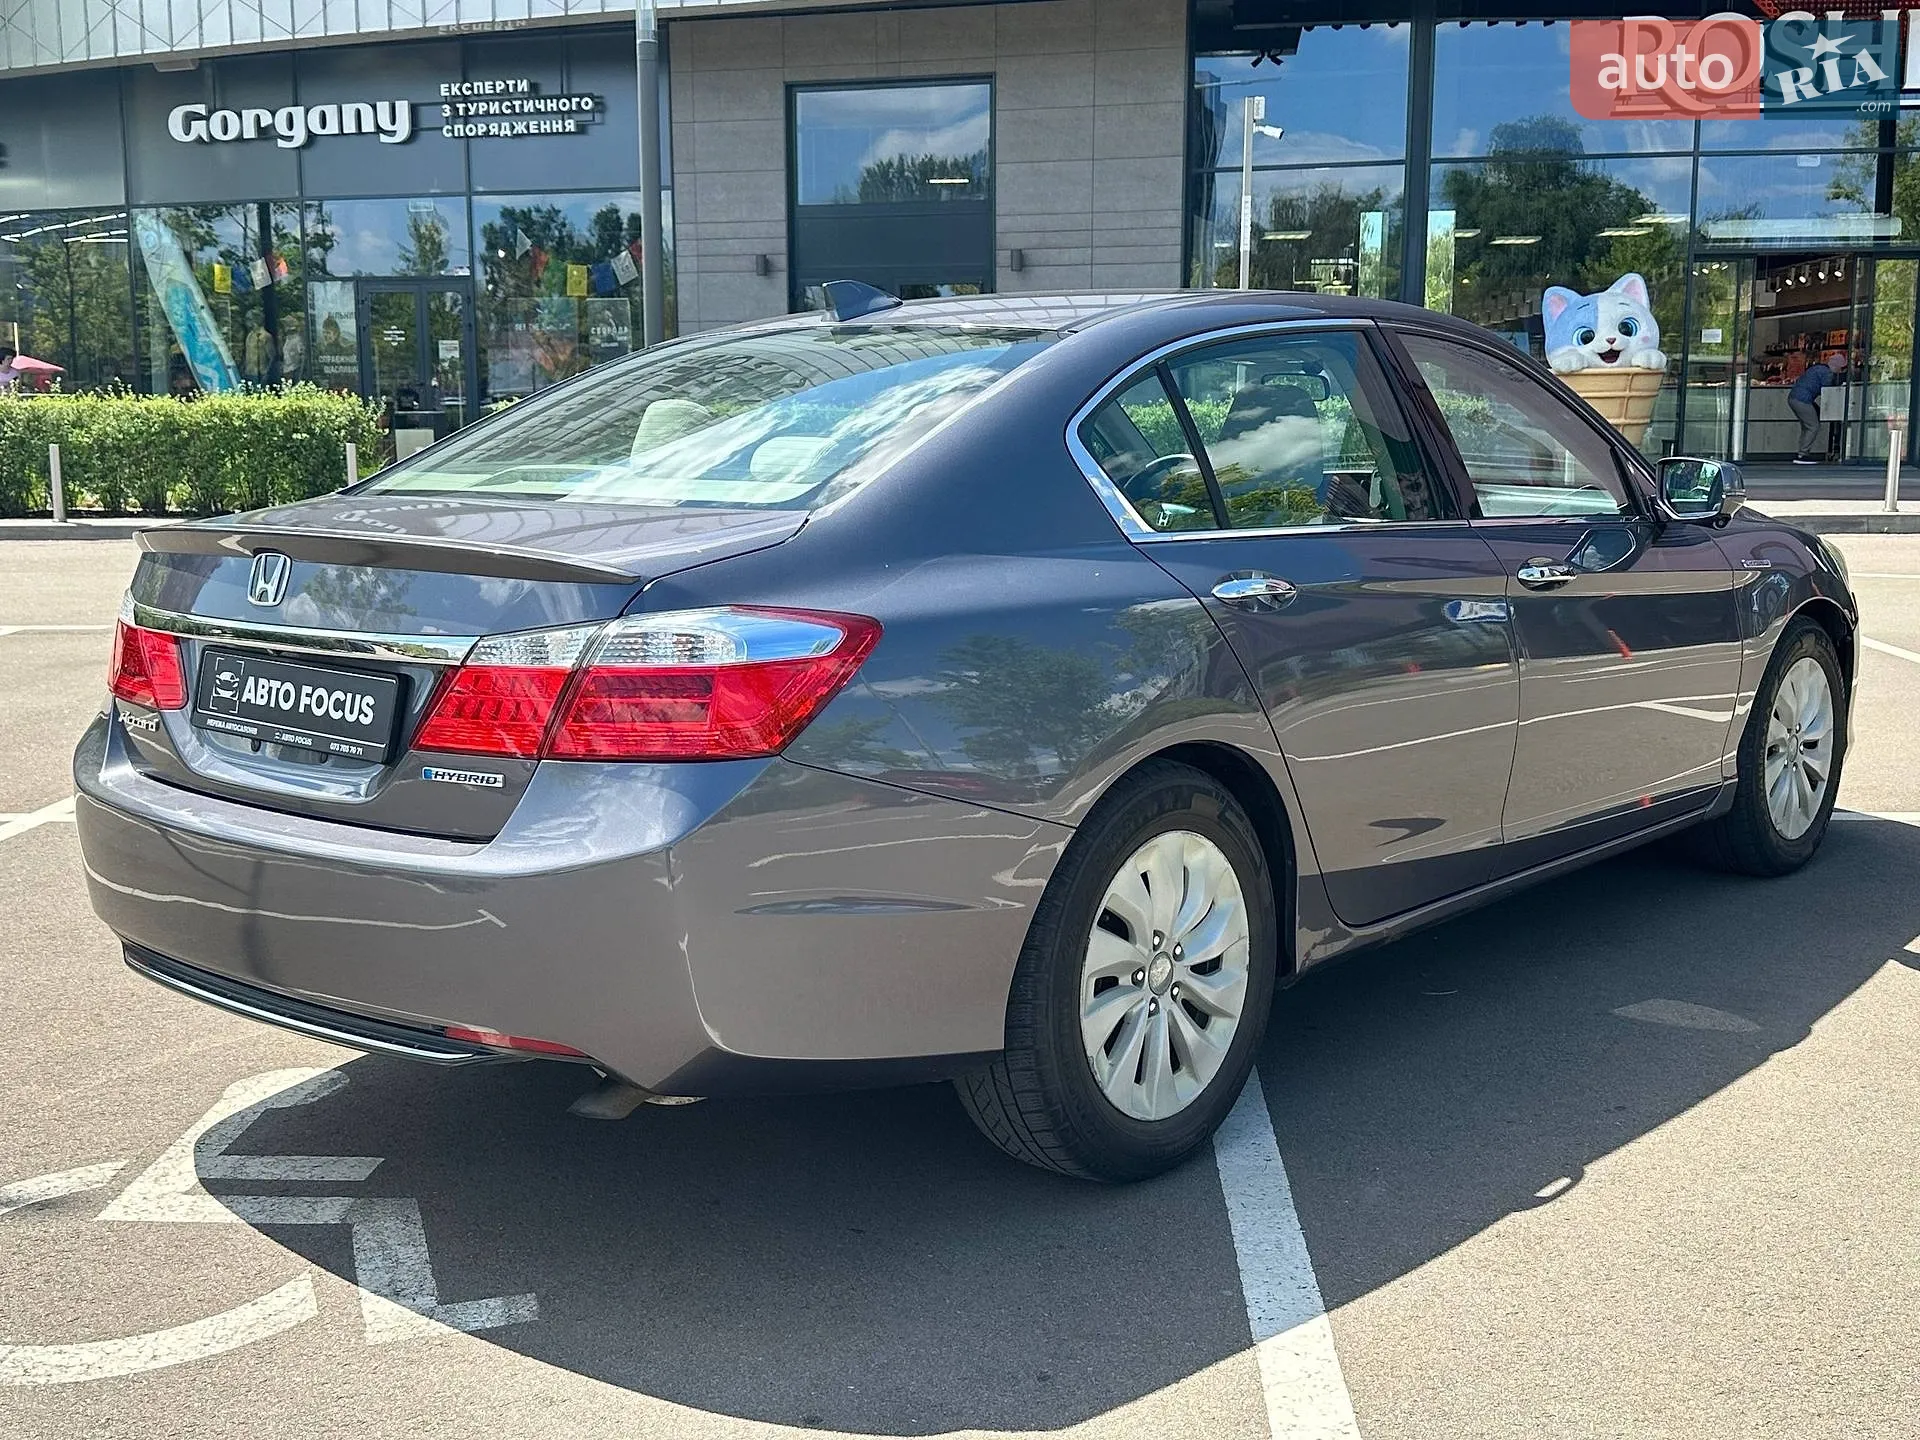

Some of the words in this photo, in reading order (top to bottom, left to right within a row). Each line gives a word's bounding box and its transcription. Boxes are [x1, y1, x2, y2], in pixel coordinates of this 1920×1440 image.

[440, 79, 528, 97] ЕКСПЕРТИ
[456, 97, 593, 116] ТУРИСТИЧНОГО
[167, 99, 412, 148] Gorgany
[442, 119, 576, 138] СПОРЯДЖЕННЯ
[299, 684, 376, 726] FOCUS
[295, 735, 313, 746] FOCUS
[434, 770, 498, 785] HYBRID
